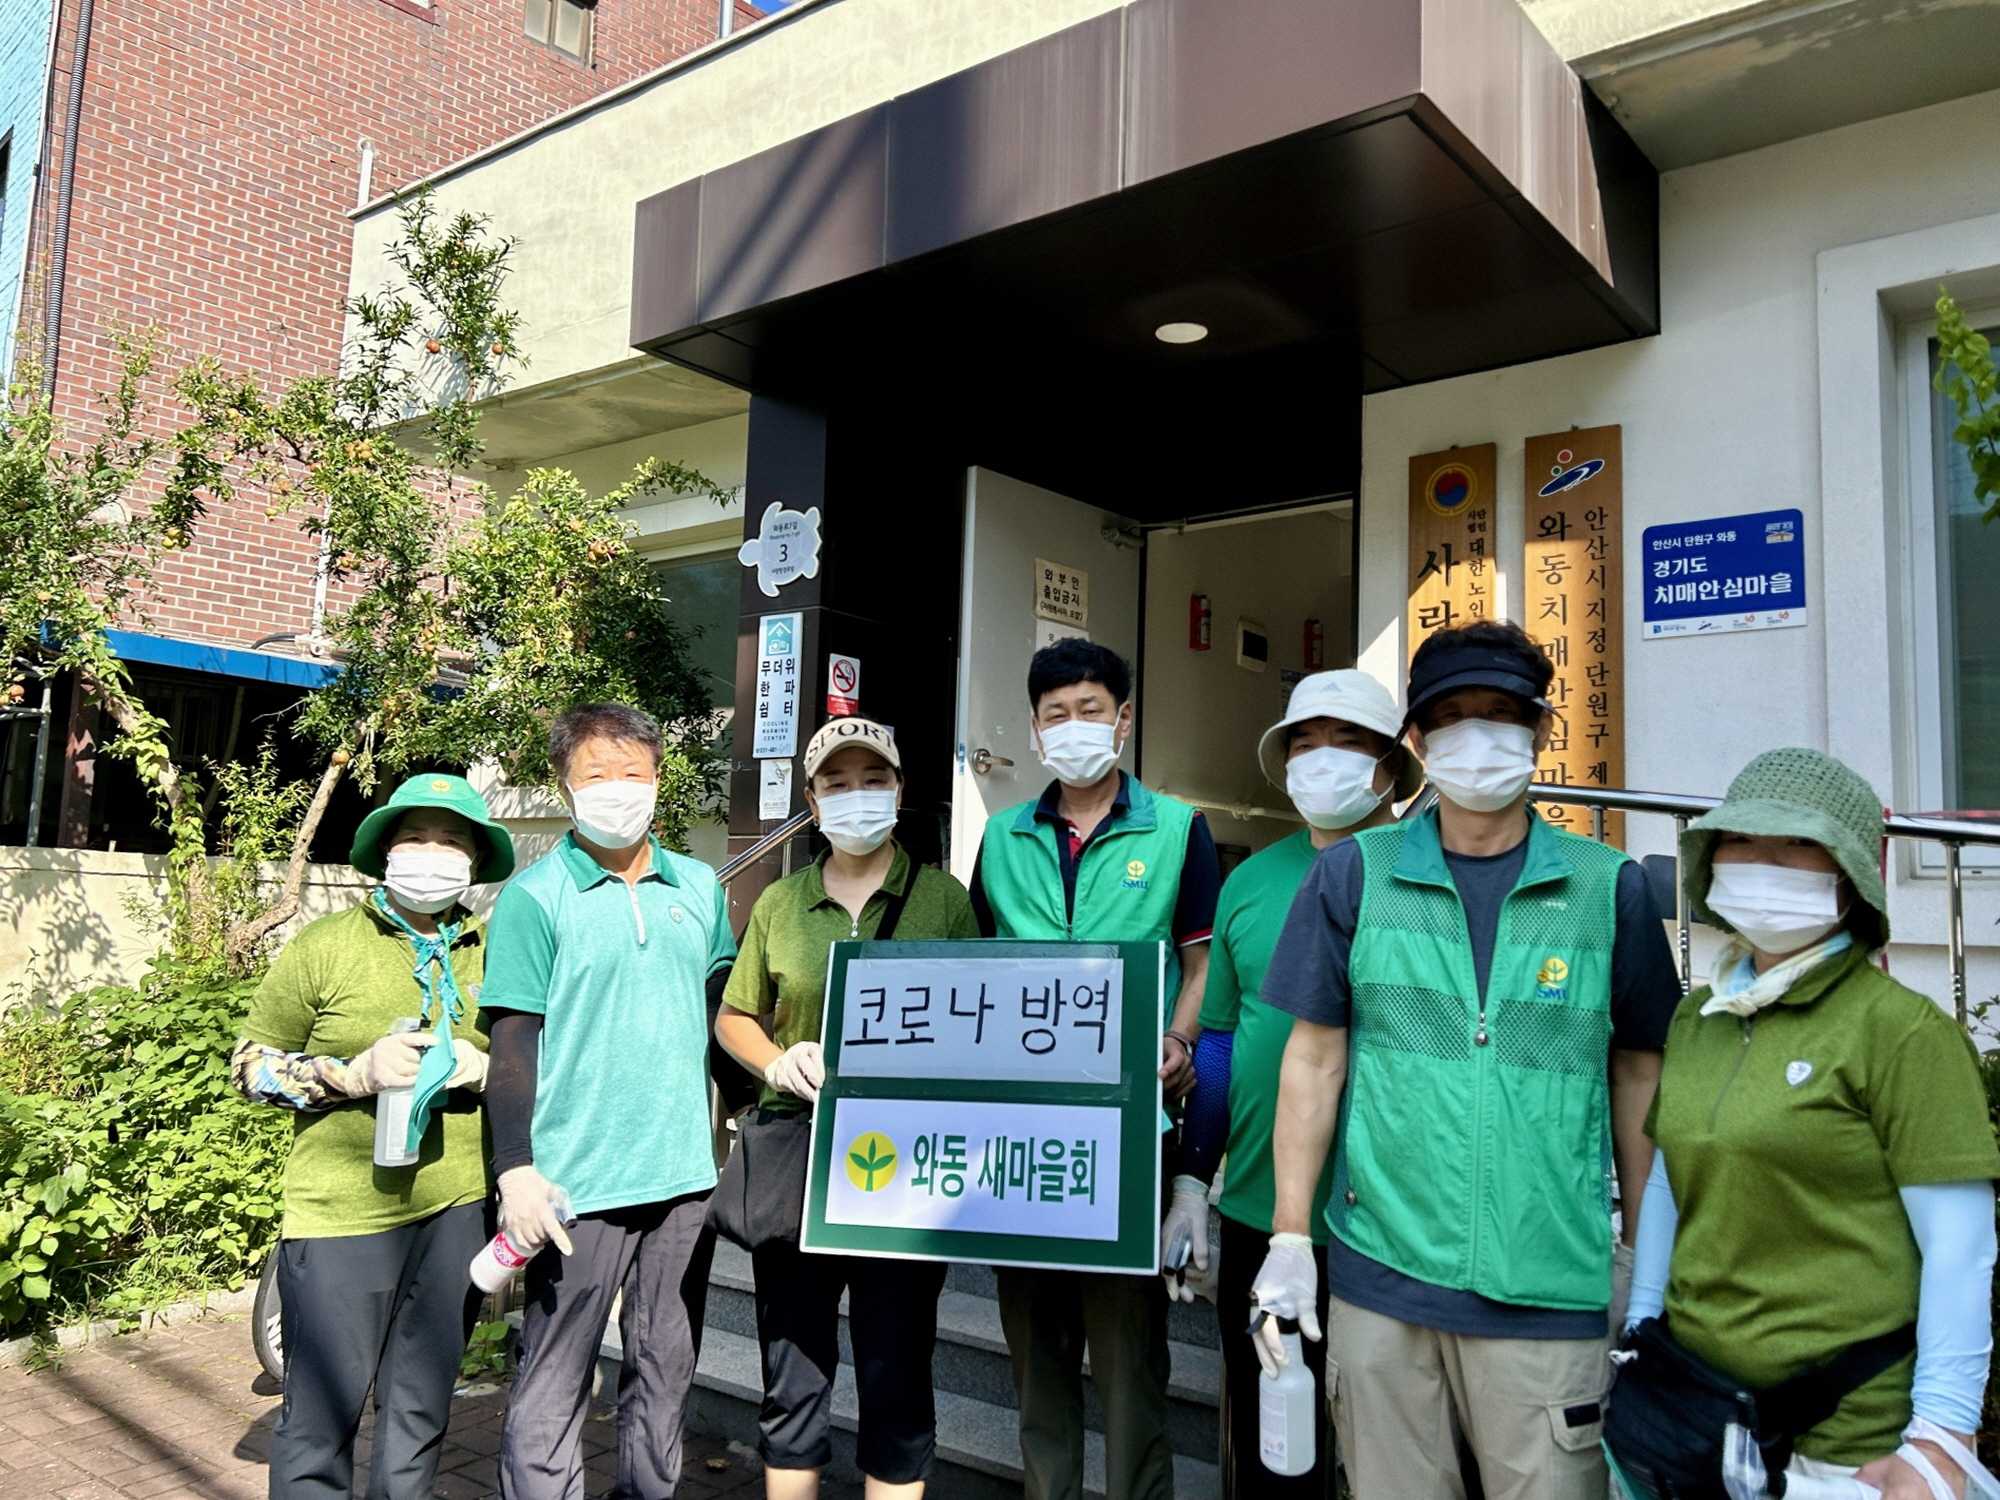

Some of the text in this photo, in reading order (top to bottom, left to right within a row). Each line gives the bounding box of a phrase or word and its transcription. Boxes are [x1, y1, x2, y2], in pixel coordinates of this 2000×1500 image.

[1652, 530, 1737, 551] 안산시 단원구 와동
[778, 543, 788, 562] 3
[1653, 556, 1708, 578] 경기도
[1043, 584, 1080, 606] 출입금지
[1653, 572, 1793, 605] 치매안심마을
[761, 657, 795, 677] 무더위
[808, 722, 894, 761] SPORT
[1122, 879, 1149, 890] SMU
[844, 977, 1110, 1056] 코로나 방역
[910, 1132, 1098, 1206] 와동 새마을회
